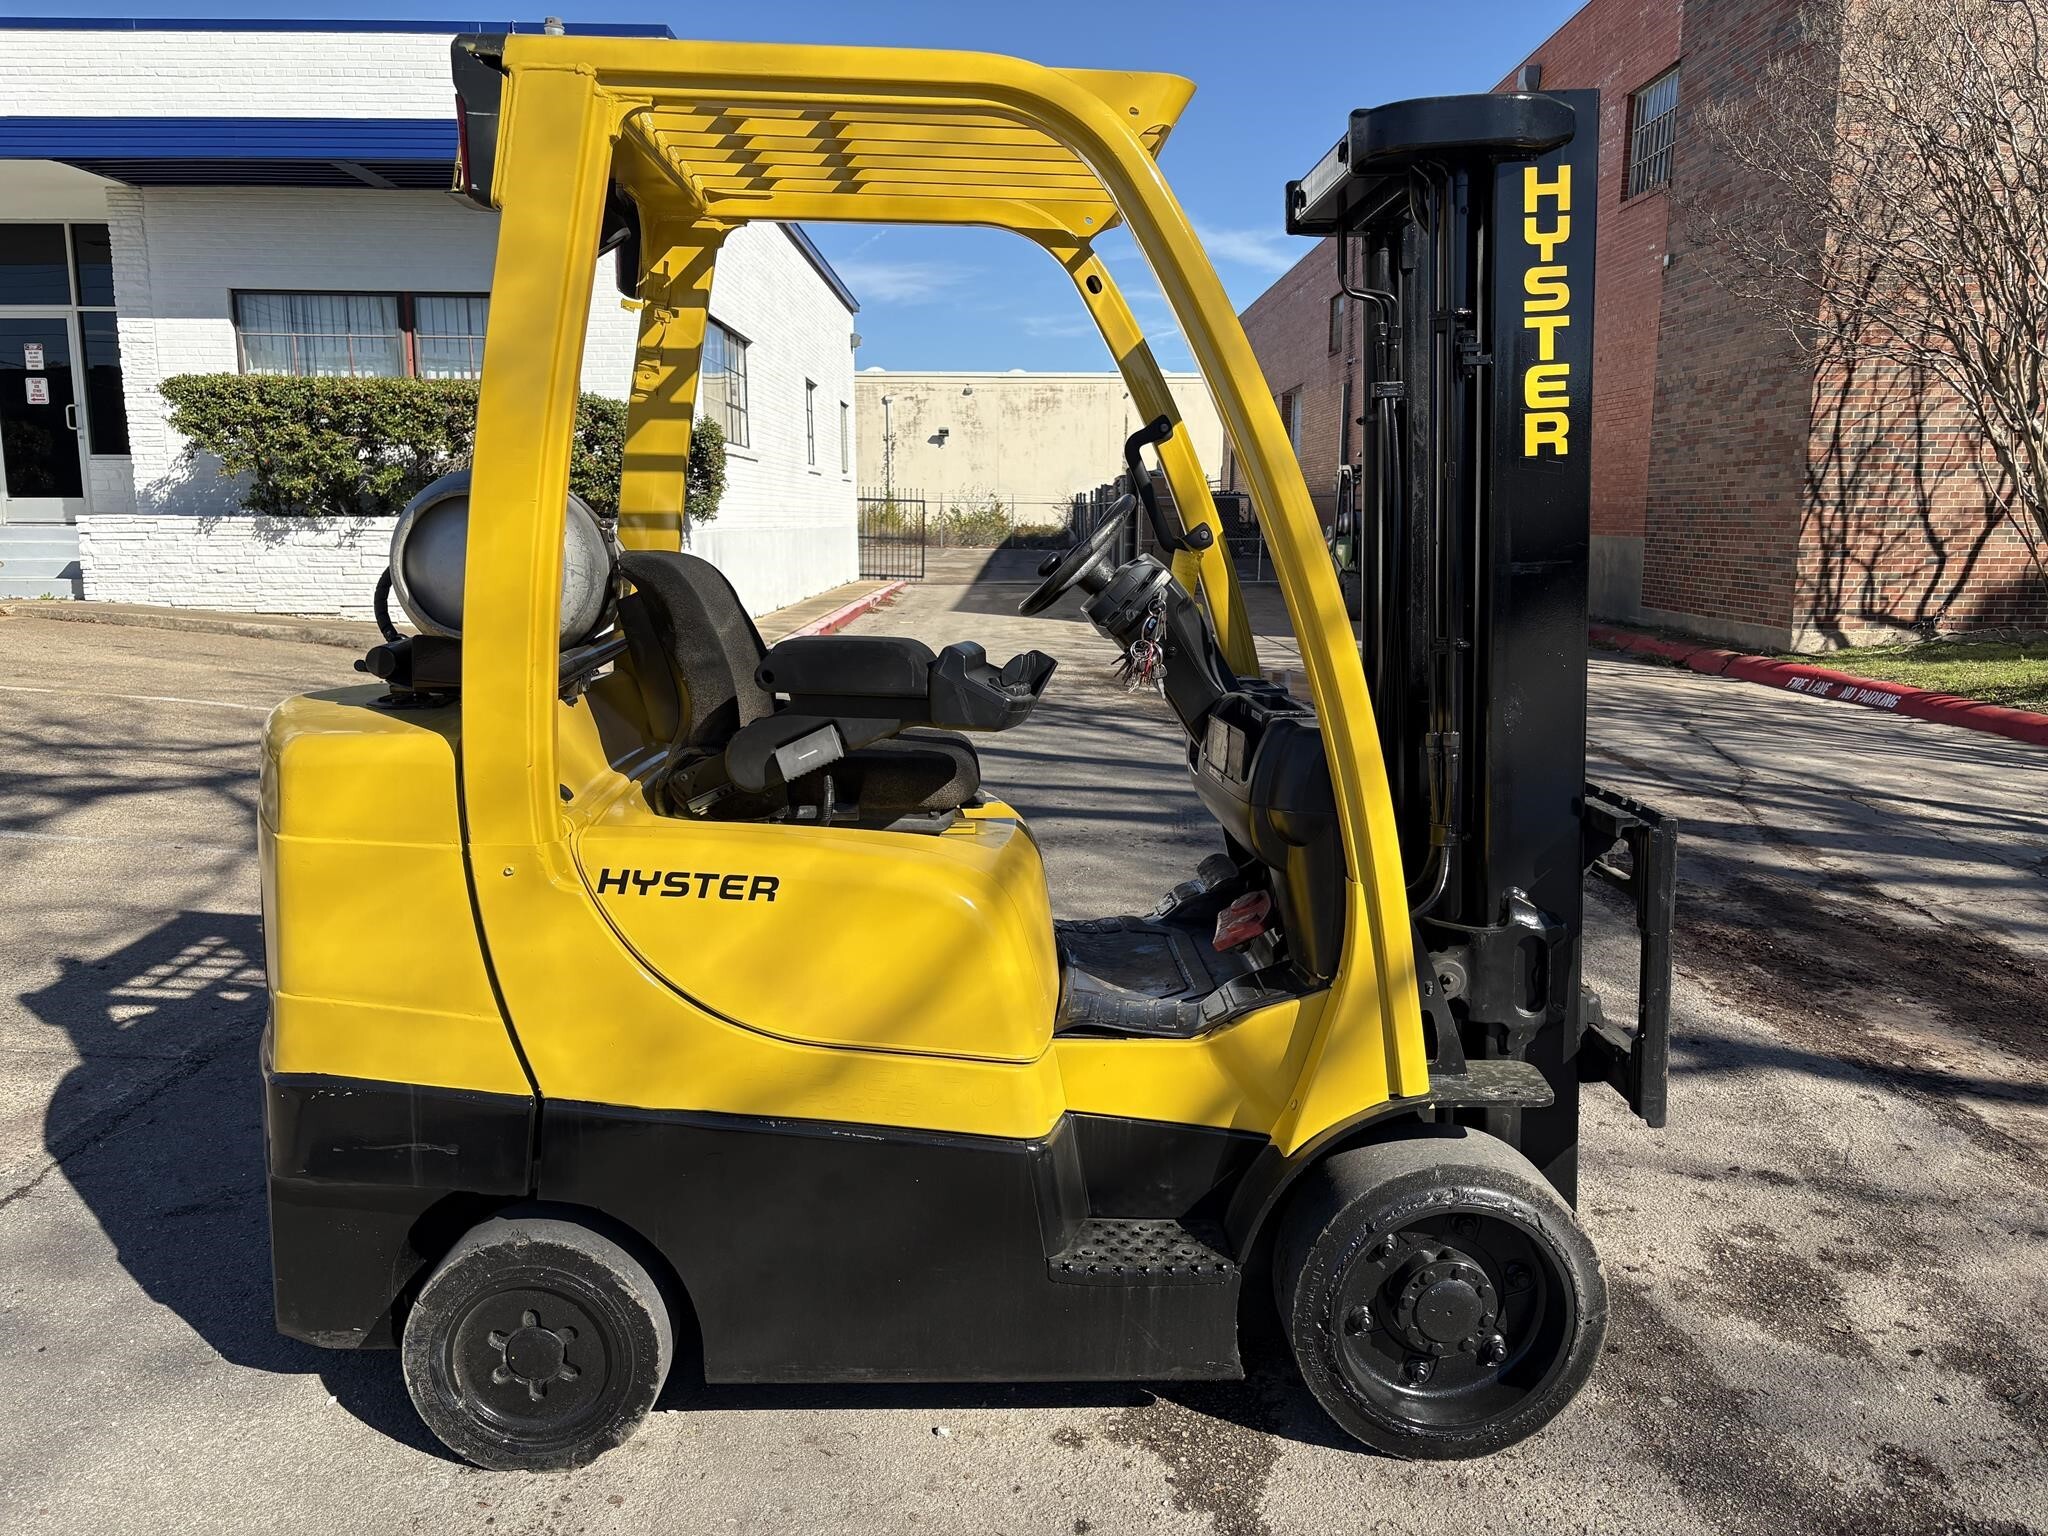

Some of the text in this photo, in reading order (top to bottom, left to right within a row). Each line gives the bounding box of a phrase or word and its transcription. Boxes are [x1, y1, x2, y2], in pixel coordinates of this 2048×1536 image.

[1523, 164, 1571, 457] HYSTER
[1785, 677, 1901, 708] FIRE LANE NO PARKING
[597, 868, 780, 902] HYSTER
